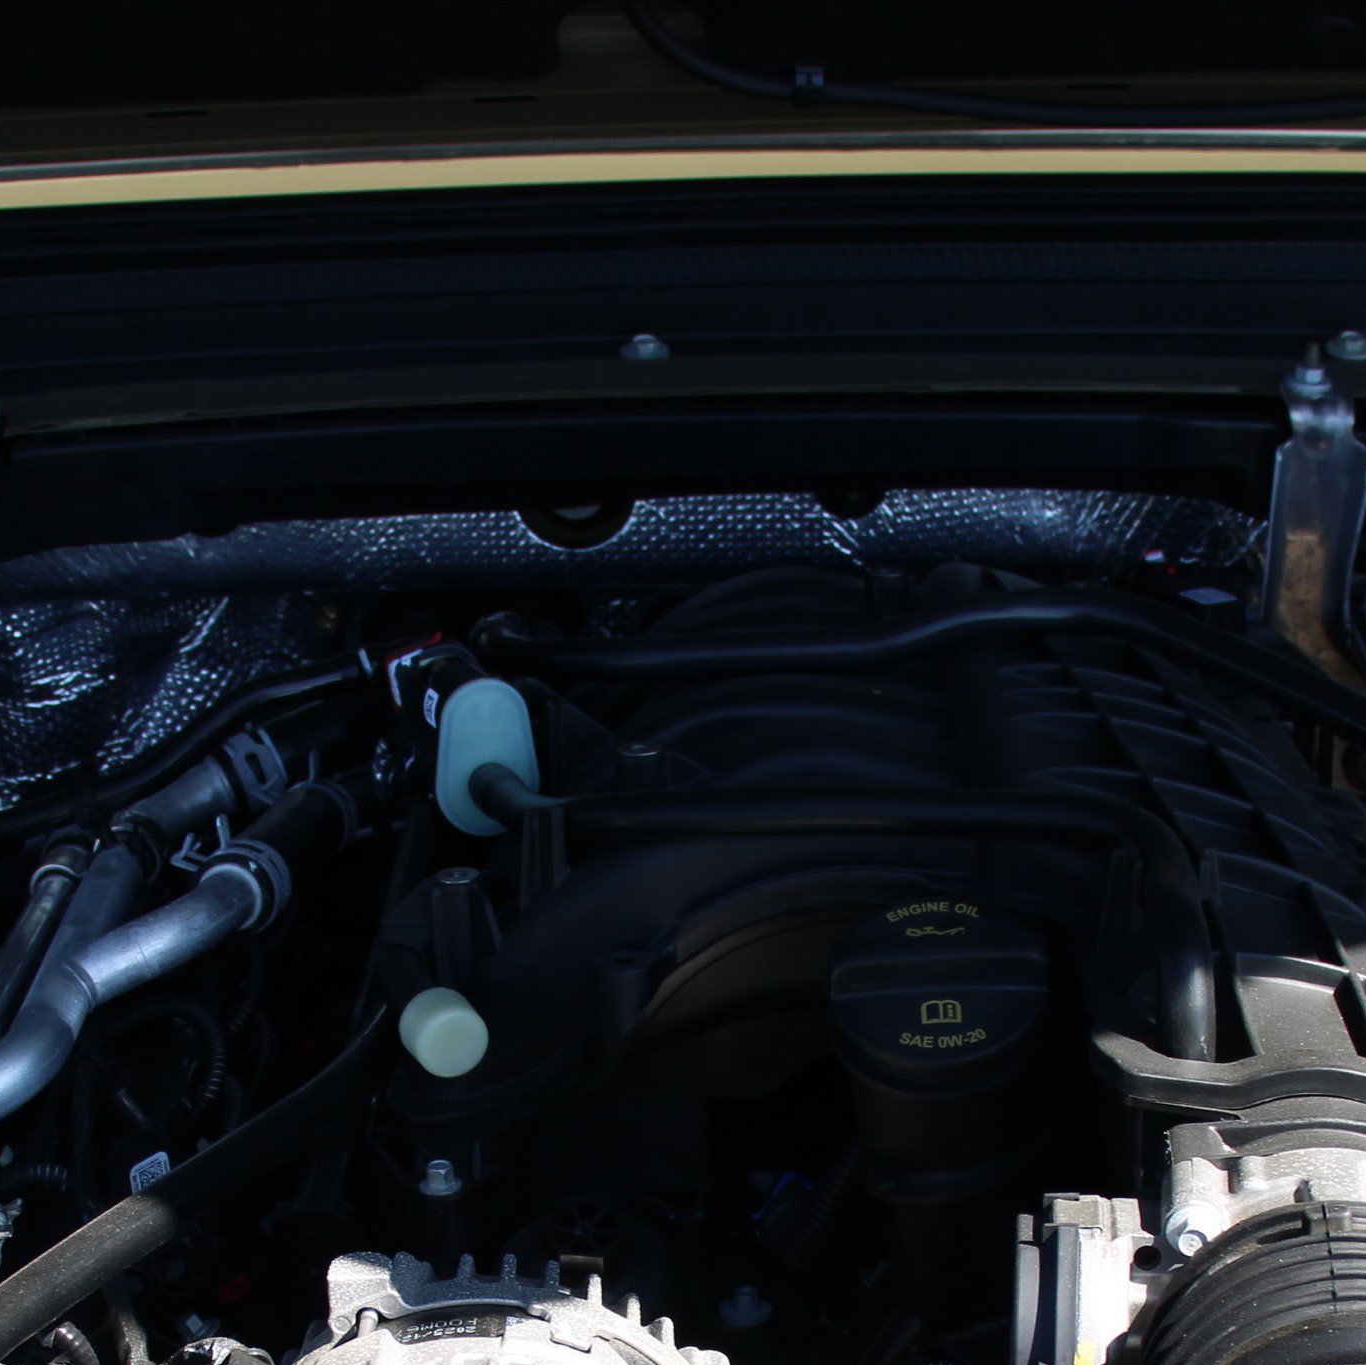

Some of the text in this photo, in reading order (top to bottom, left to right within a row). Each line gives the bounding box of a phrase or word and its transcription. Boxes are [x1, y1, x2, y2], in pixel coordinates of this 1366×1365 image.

[885, 901, 981, 923] ENGINE OIL
[899, 1028, 987, 1049] SAE 0W-20
